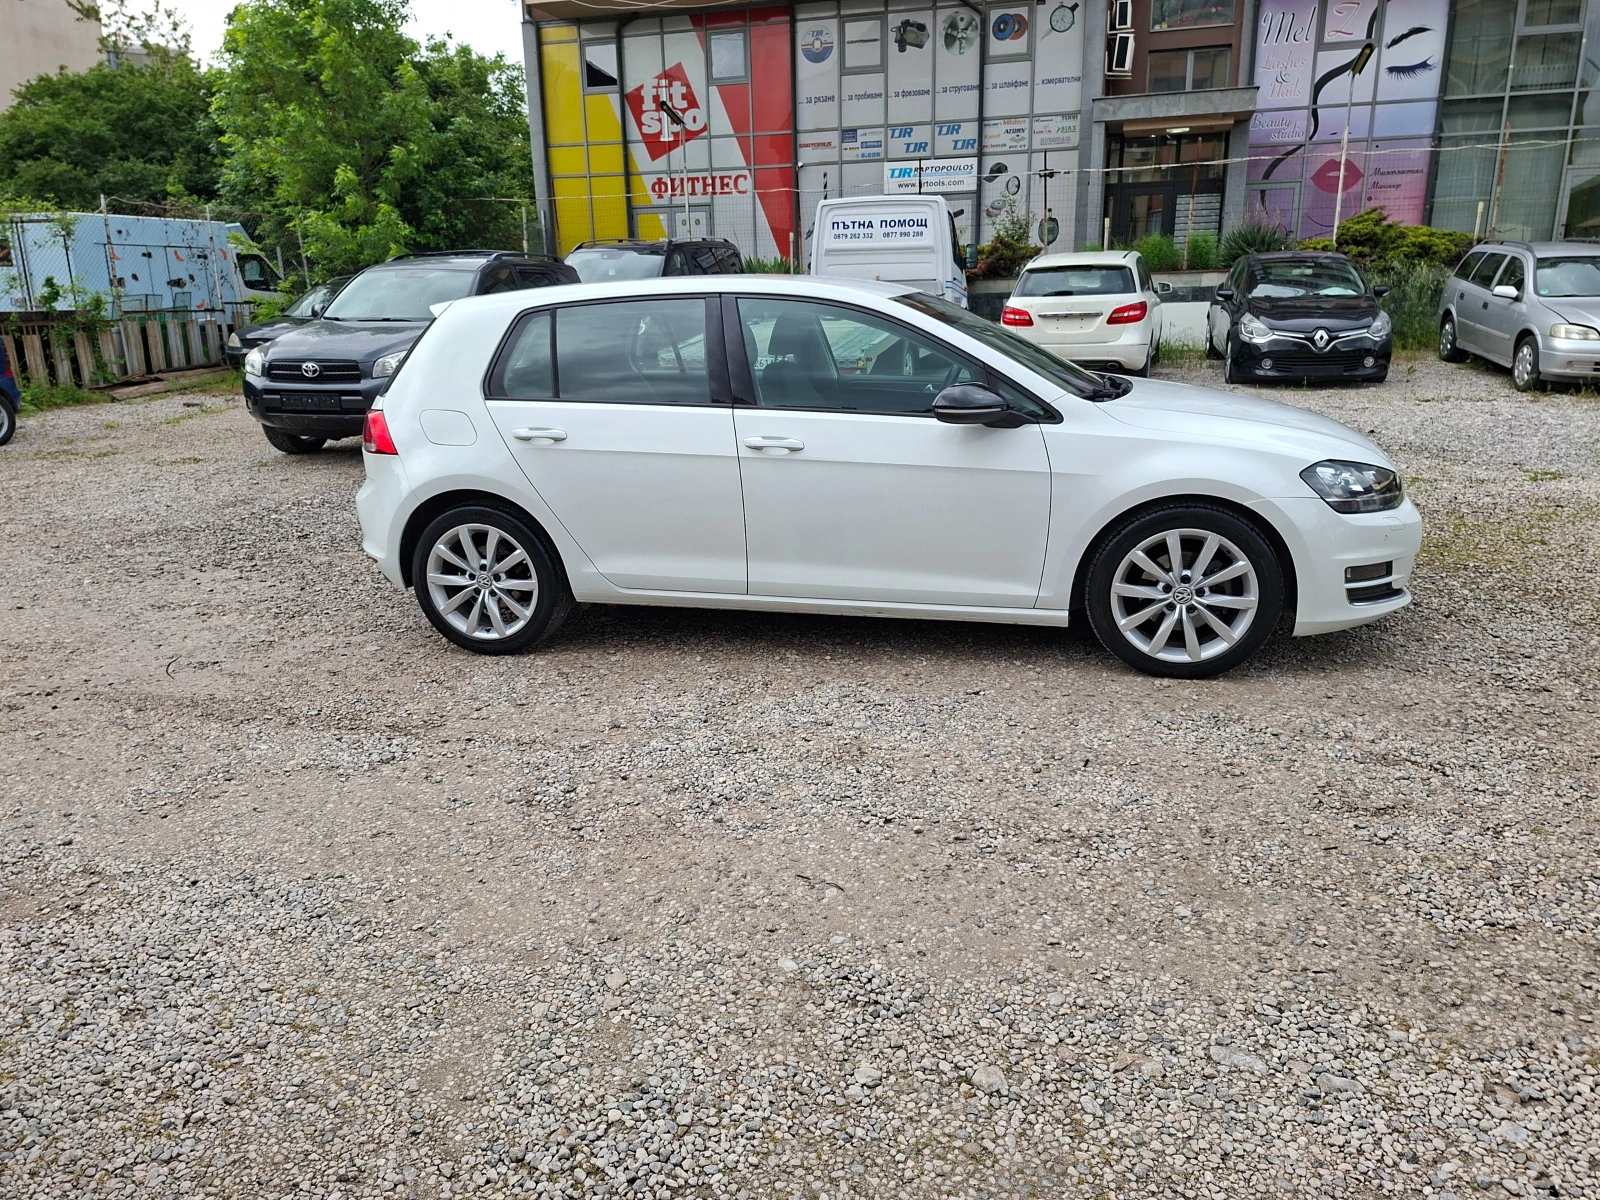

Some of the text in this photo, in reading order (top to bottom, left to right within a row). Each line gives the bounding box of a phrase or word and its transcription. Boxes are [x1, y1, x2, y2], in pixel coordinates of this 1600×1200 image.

[1262, 1, 1360, 45] Mel Z
[1259, 50, 1305, 70] Lashes
[1275, 69, 1289, 83] &
[948, 84, 980, 95] струговане
[999, 78, 1029, 89] шлайфане
[1269, 79, 1302, 98] Nails
[641, 79, 688, 110] fit
[813, 95, 835, 105] рязане
[854, 91, 883, 102] пробиване
[901, 89, 931, 99] фрезоване
[641, 108, 706, 141] spo
[1251, 112, 1290, 130] Beauty
[889, 127, 914, 139] TJR
[936, 123, 962, 136] TJR
[1271, 123, 1304, 140] studio
[904, 141, 929, 153] TJR
[951, 138, 977, 151] TJR
[889, 167, 913, 179] TJR
[913, 164, 974, 173] RAPTOPOULOS
[651, 174, 748, 199] ФИТНЕС
[832, 218, 928, 230] ПЪТНА ПОМОЩ
